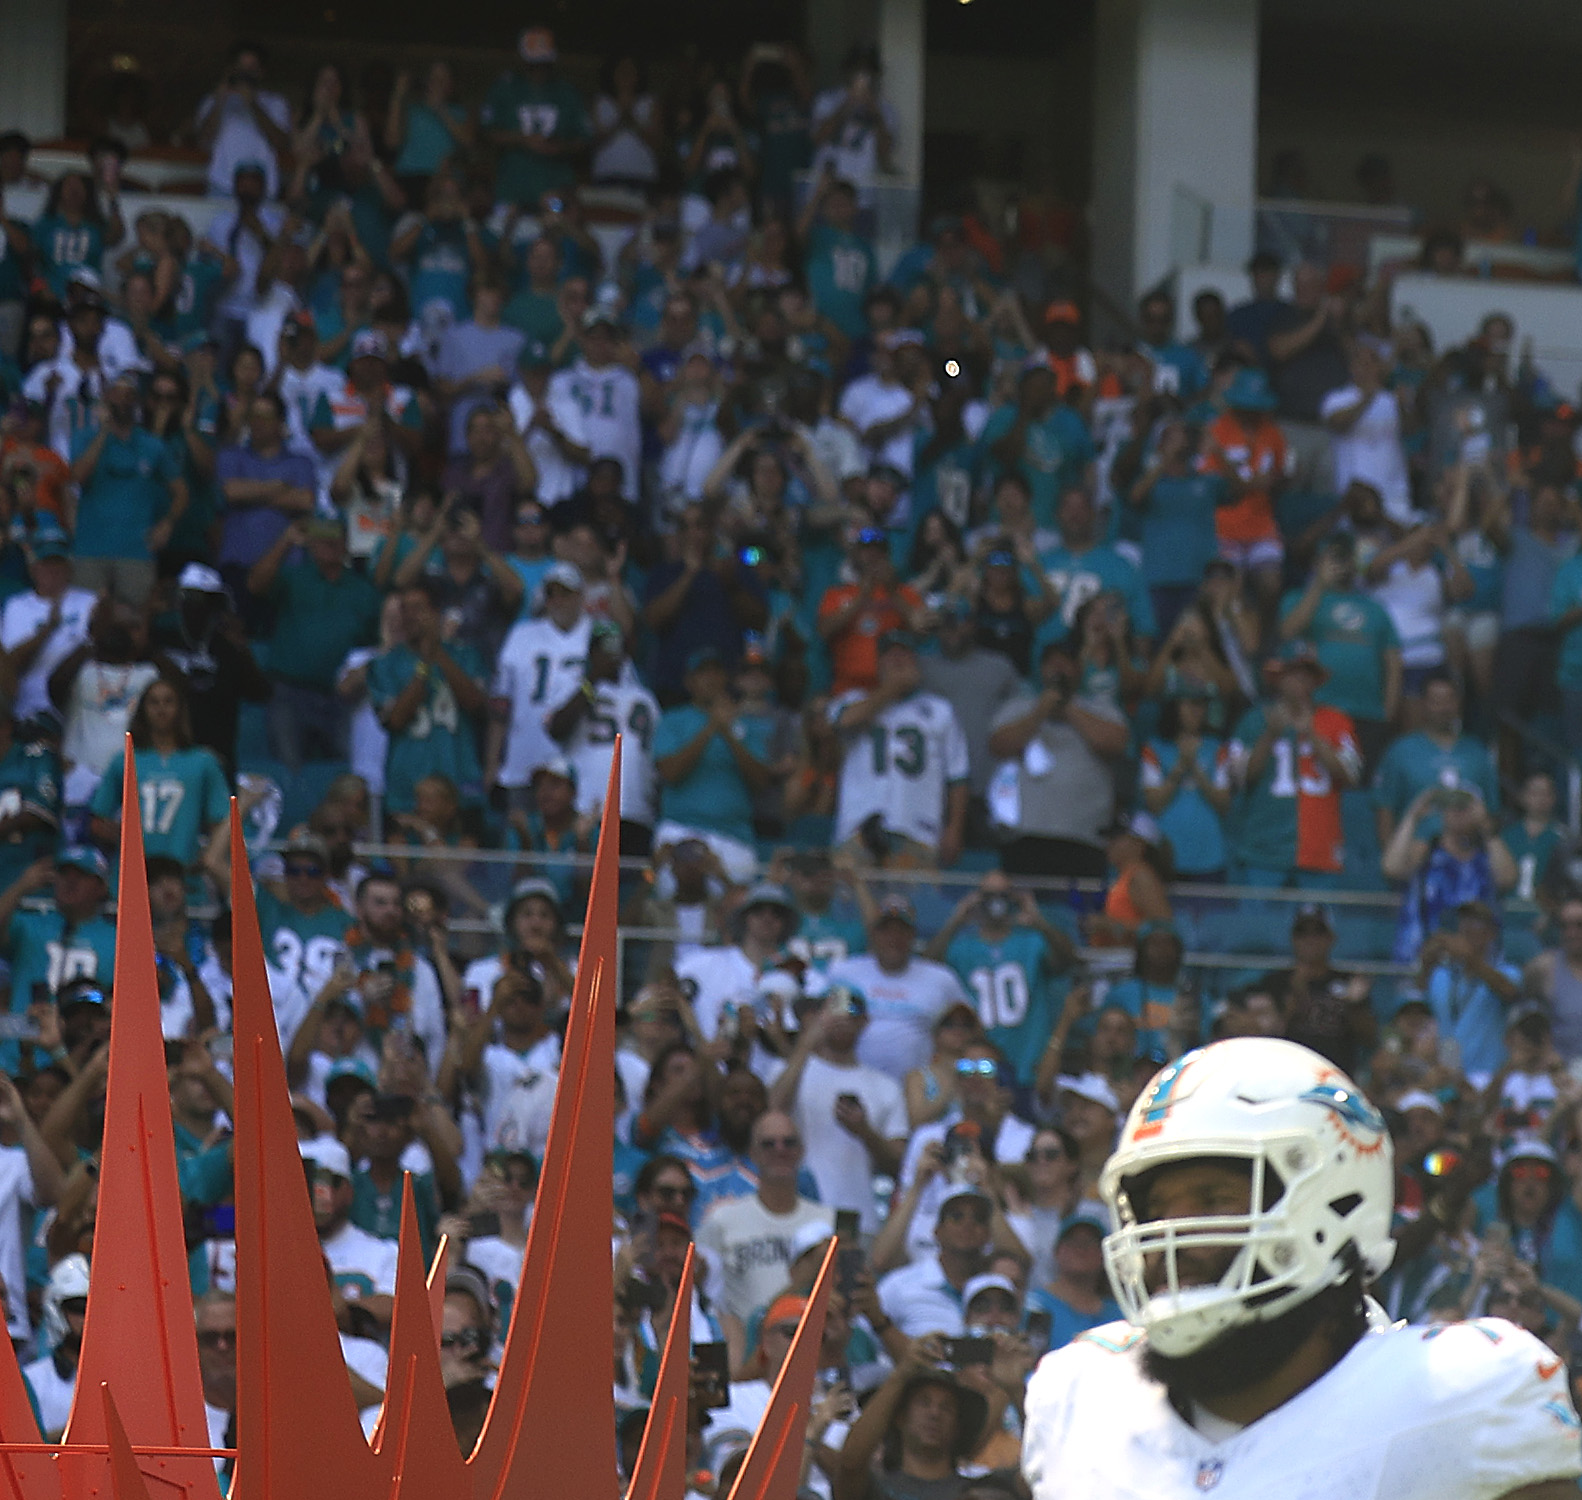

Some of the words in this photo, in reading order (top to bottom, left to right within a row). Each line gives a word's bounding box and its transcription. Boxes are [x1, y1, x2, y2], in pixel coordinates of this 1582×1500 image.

[873, 726, 926, 781] 13
[142, 781, 185, 835] 17
[971, 962, 1028, 1026] 10
